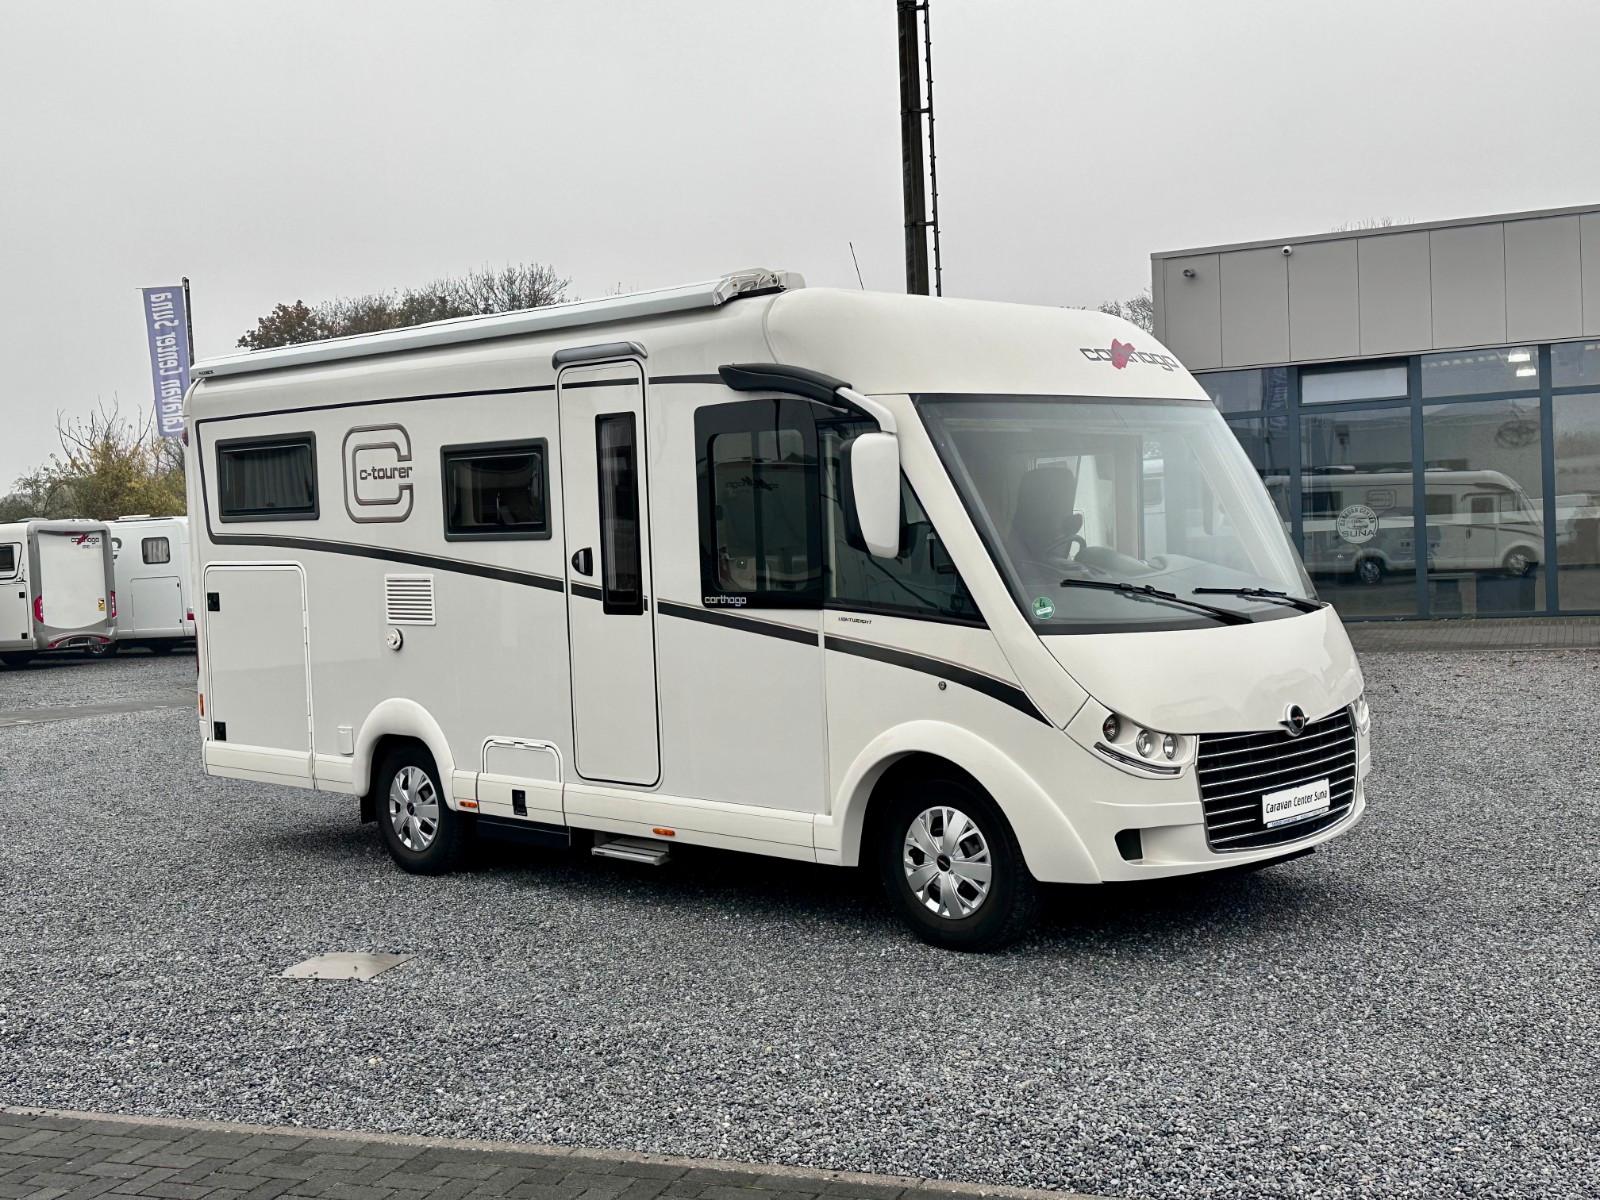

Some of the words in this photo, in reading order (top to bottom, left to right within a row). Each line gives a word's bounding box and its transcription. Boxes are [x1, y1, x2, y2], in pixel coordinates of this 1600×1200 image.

[1079, 348, 1180, 372] cahago
[359, 465, 413, 480] c-tourer
[1341, 529, 1375, 538] SUNA
[704, 594, 747, 607] carthago
[1265, 800, 1292, 814] Caravan
[1293, 794, 1313, 807] Center
[1314, 790, 1328, 801] Suna
